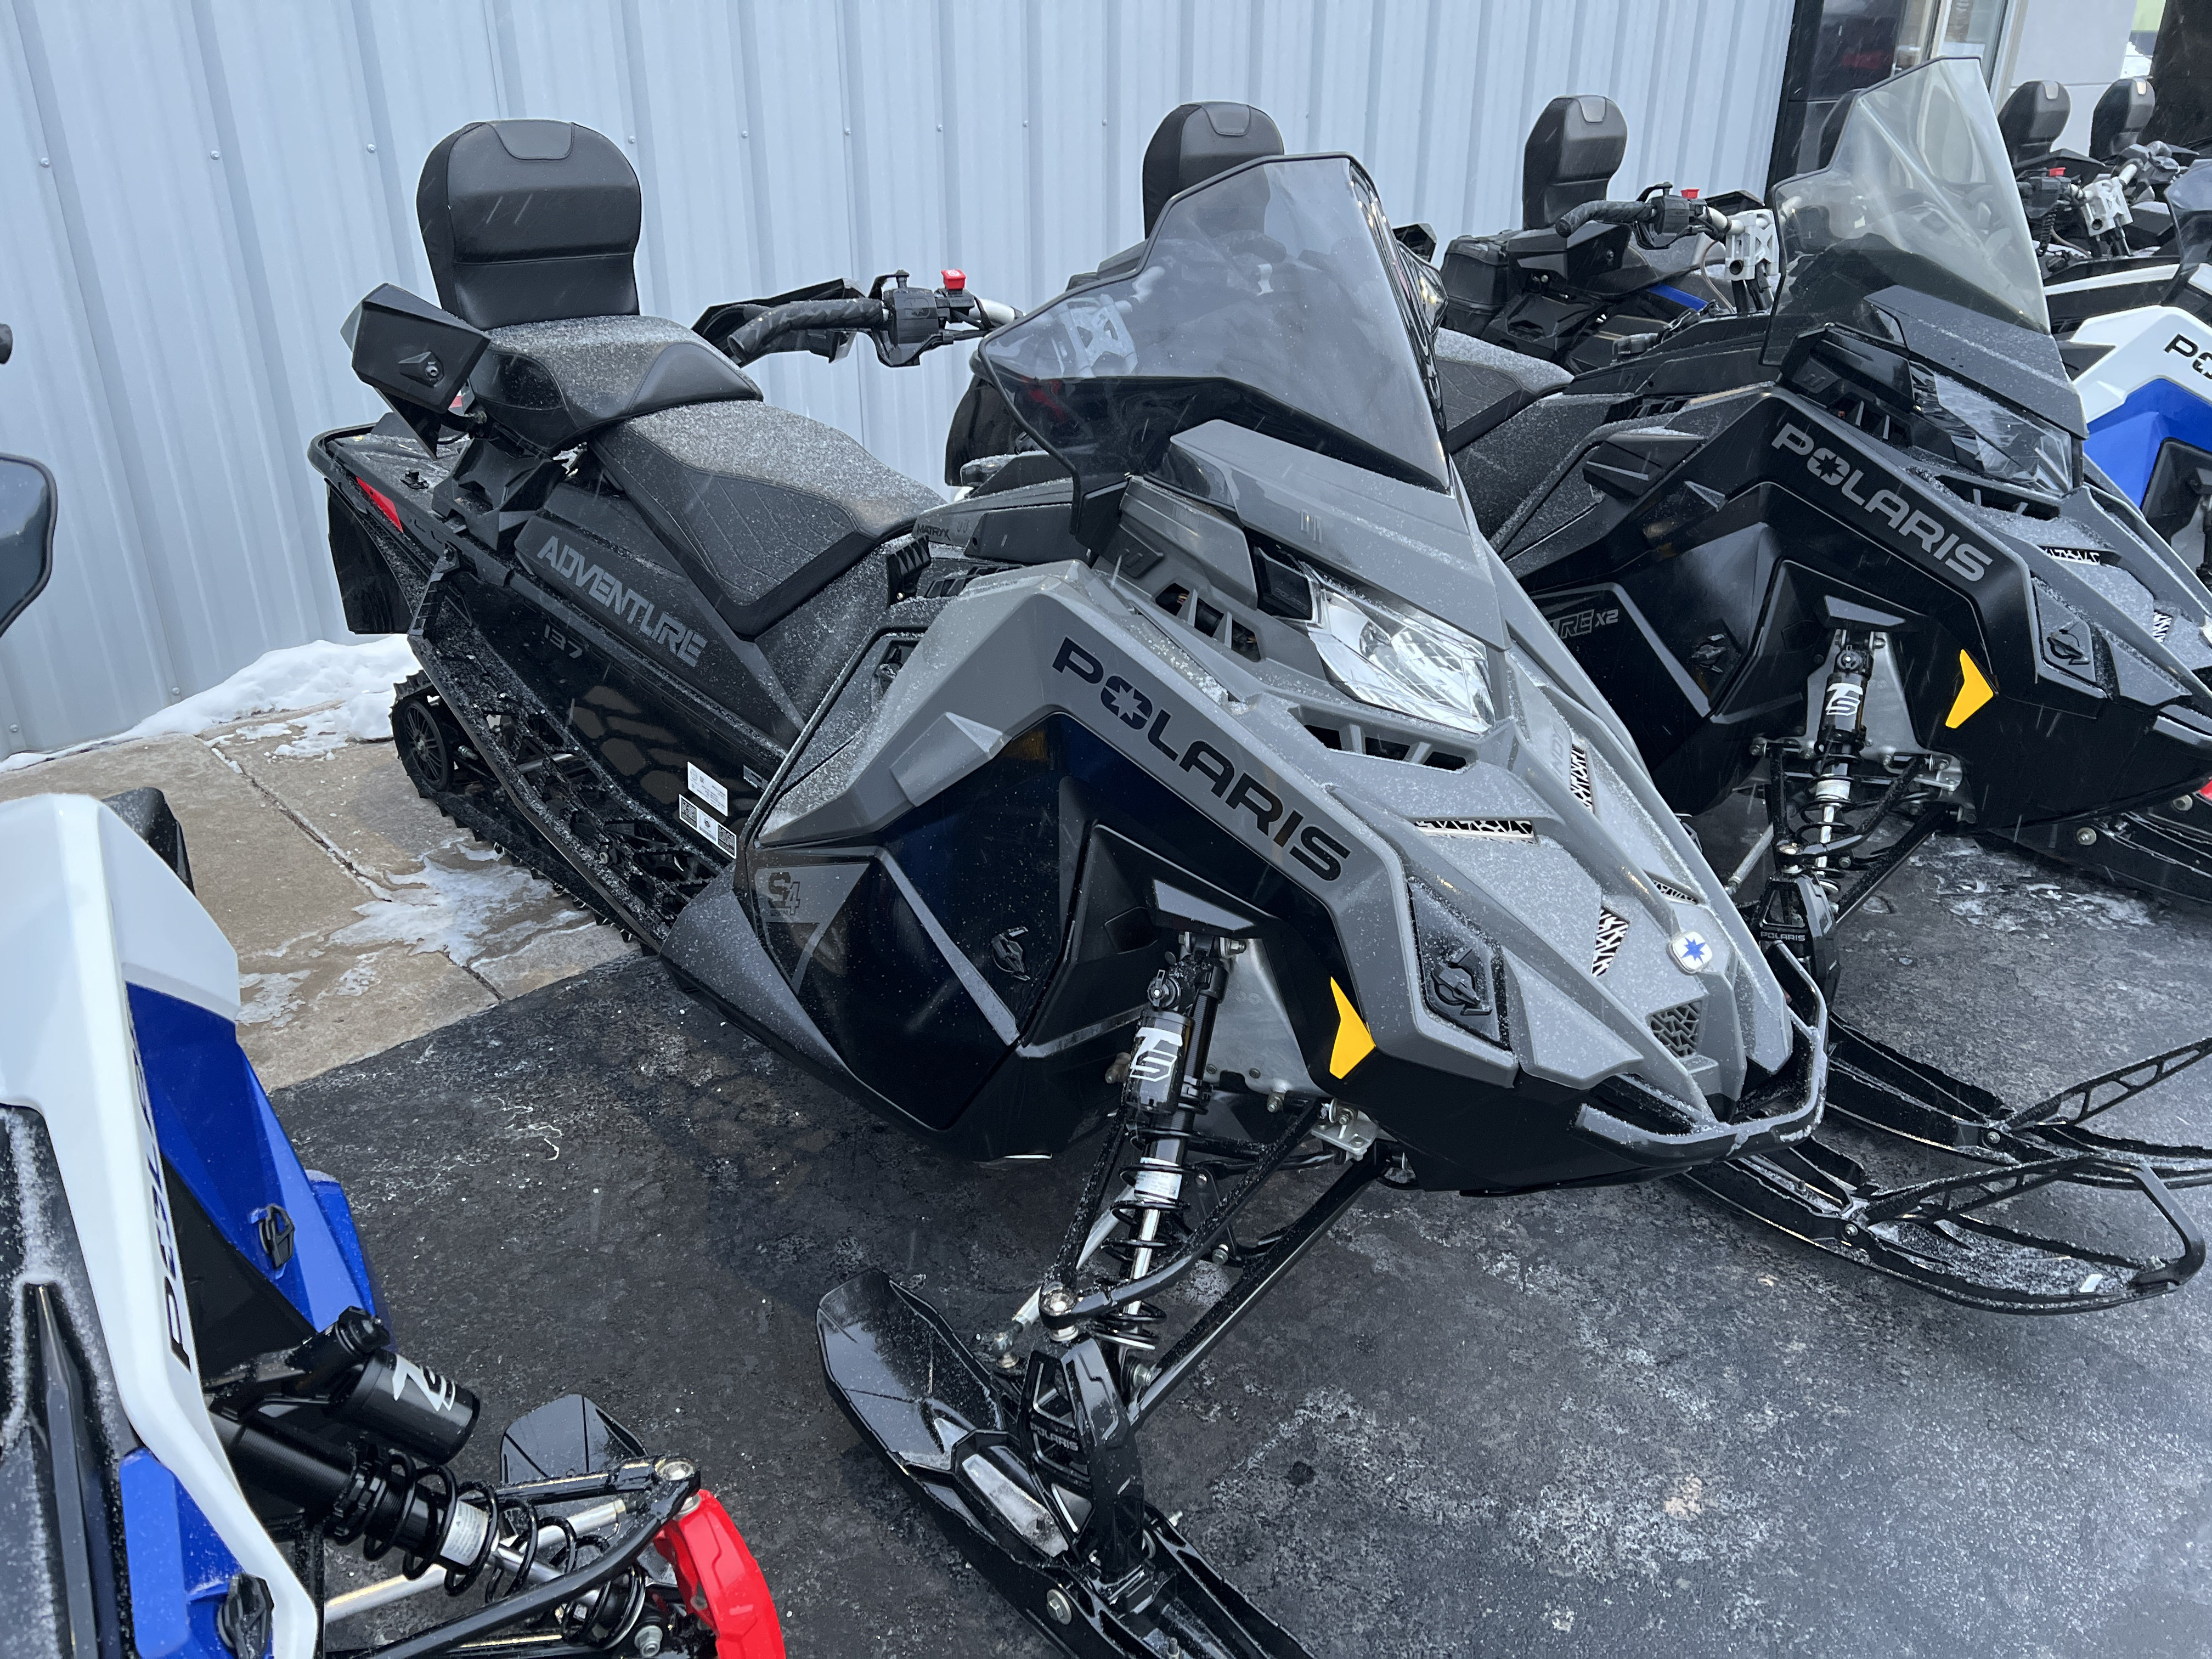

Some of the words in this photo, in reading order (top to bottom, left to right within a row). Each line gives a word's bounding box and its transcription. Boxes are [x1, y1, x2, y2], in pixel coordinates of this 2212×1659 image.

[1771, 423, 1993, 582] POLARIS
[537, 535, 709, 668] ADVENTURE
[1594, 608, 1618, 628] X2
[544, 624, 583, 659] 137
[1052, 636, 1351, 882] POLARIS
[1760, 931, 1805, 941] POLARIS
[1030, 1421, 1079, 1452] POLARIS
